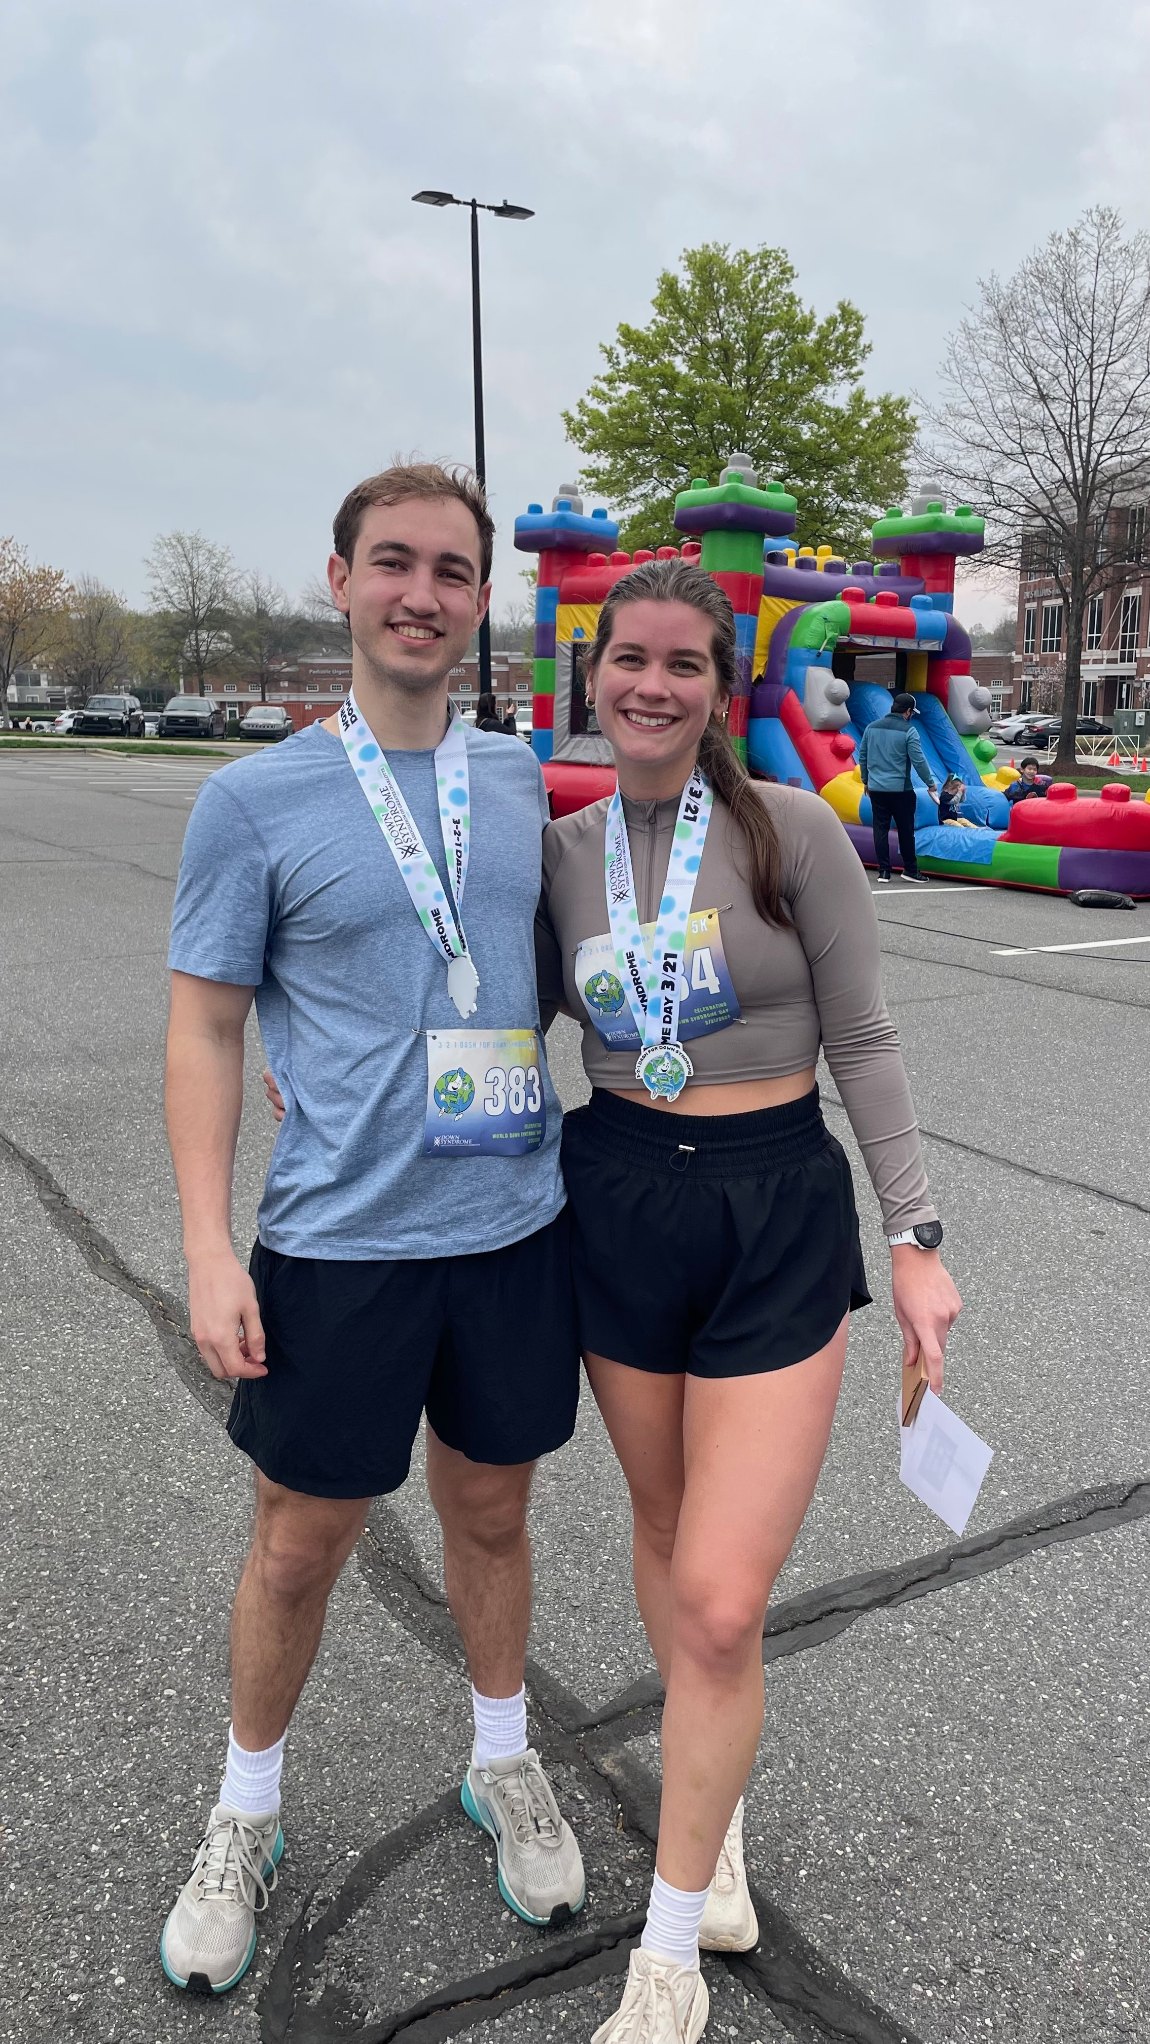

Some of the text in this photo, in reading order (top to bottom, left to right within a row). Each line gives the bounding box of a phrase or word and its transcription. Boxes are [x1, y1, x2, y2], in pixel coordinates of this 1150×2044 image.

[379, 785, 413, 845] SYNDROME
[683, 786, 703, 822] 3/21
[381, 812, 403, 846] DOWN
[452, 818, 463, 848] 3-2-1
[455, 848, 463, 885] DASH
[609, 859, 618, 892] DOWN
[614, 833, 626, 890] SYNDROME
[691, 917, 708, 935] 5K
[660, 952, 678, 992] 3/21
[662, 997, 674, 1025] DAY
[460, 1041, 476, 1049] DASH
[639, 1053, 649, 1066] DASH
[648, 1046, 658, 1054] FOR
[483, 1066, 541, 1116] 383
